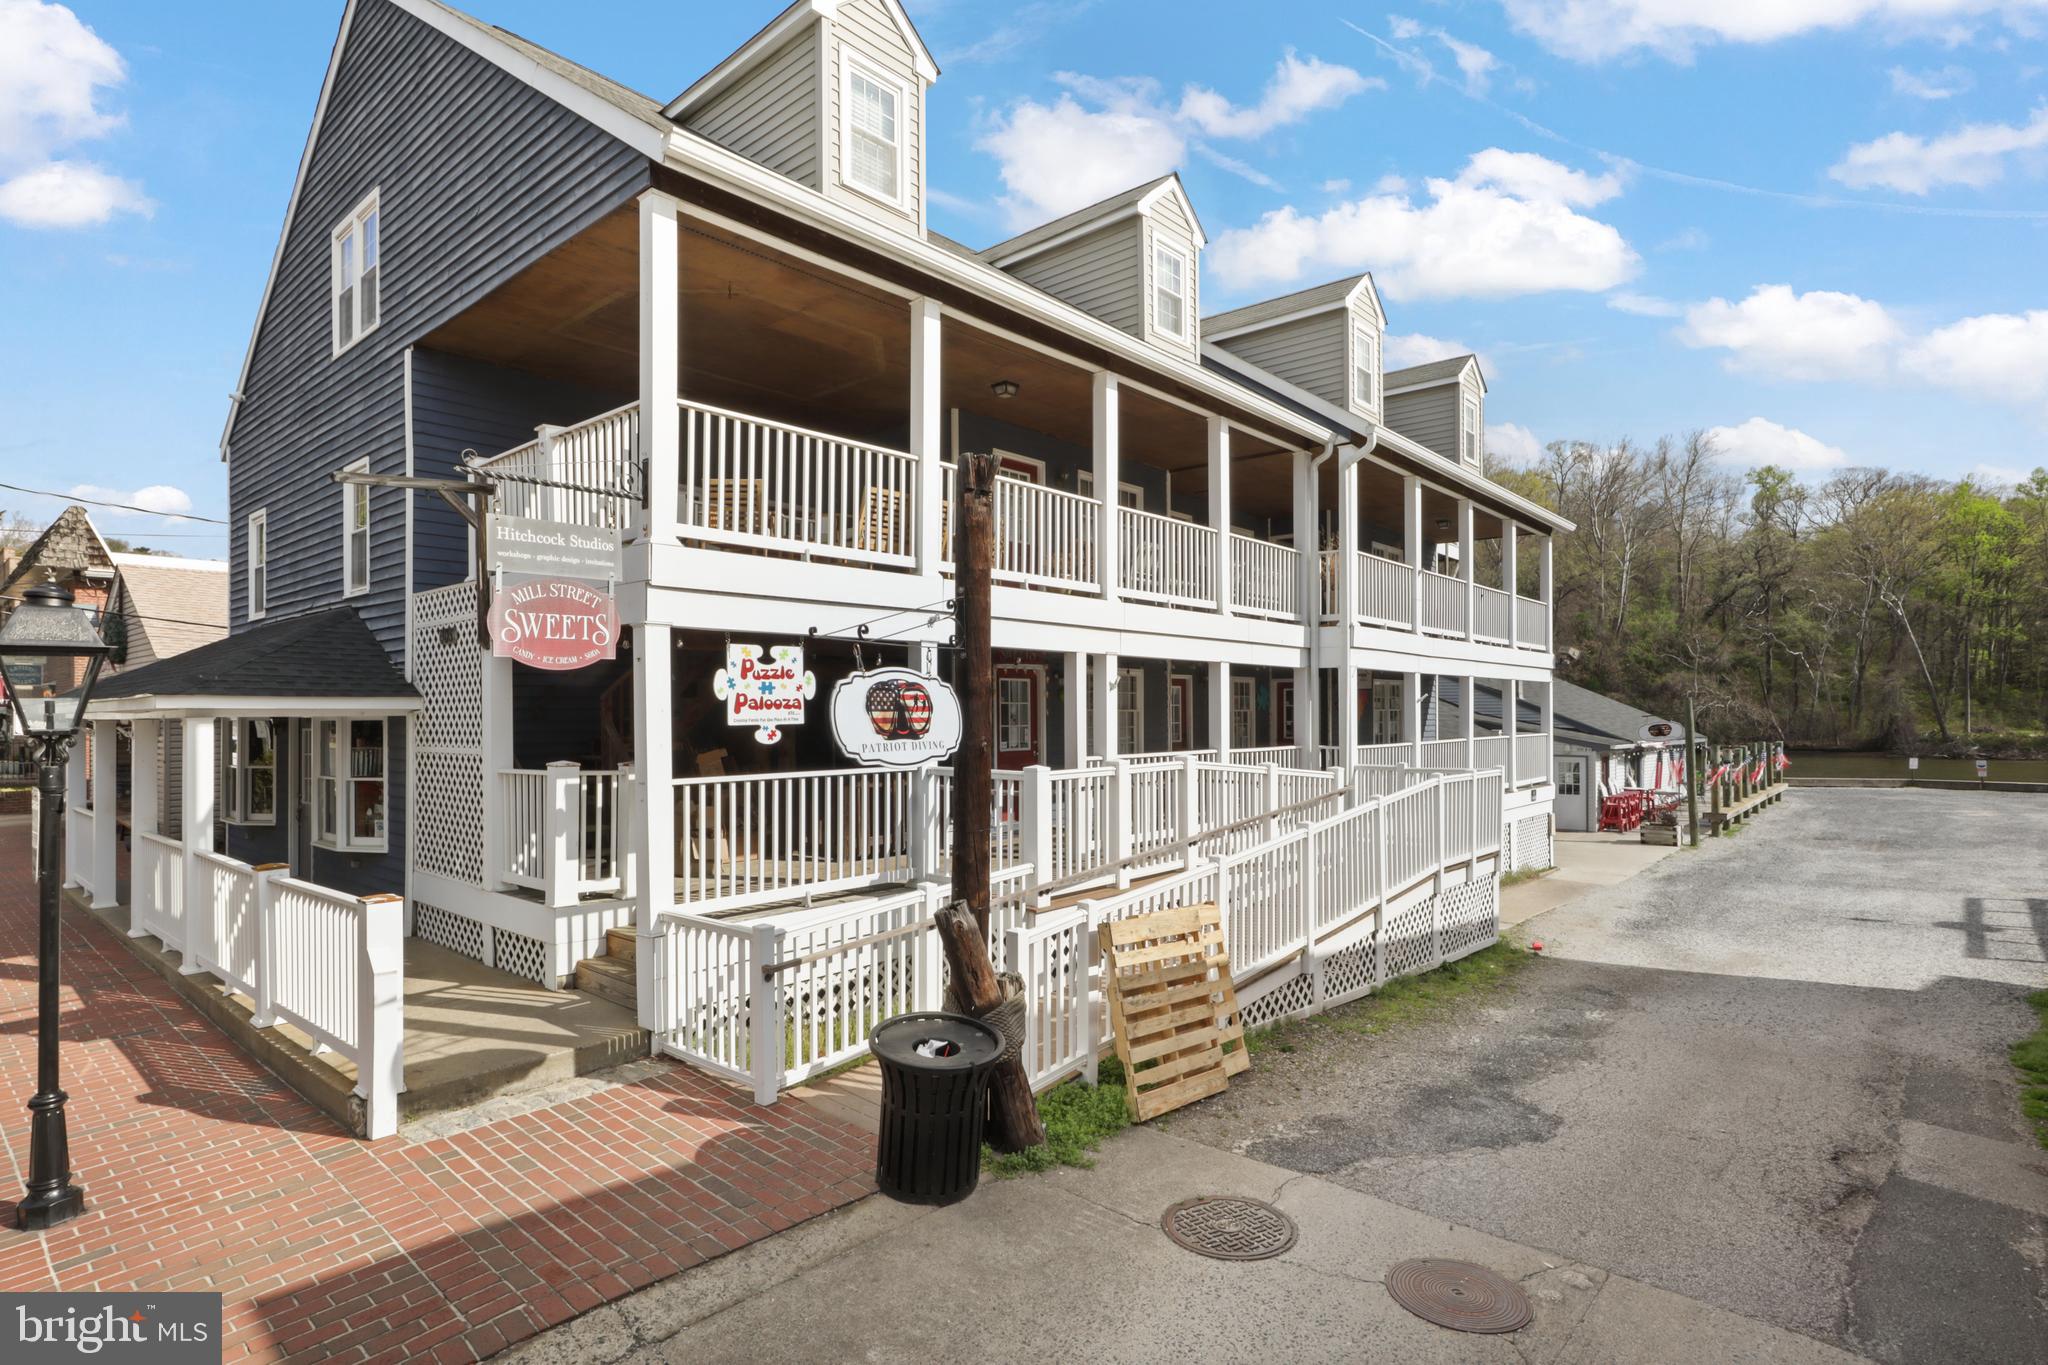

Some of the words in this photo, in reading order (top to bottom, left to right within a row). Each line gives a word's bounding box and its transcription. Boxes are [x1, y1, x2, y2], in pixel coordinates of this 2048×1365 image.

[496, 526, 566, 547] Hitchcock
[570, 534, 615, 551] Studios
[511, 584, 547, 605] MILL
[549, 583, 602, 609] STREET
[501, 608, 610, 646] SWEETS
[512, 645, 535, 660] CANDY
[542, 655, 555, 663] ICE
[555, 655, 578, 664] CREAM
[740, 658, 795, 681] Puzzle
[733, 692, 802, 714] Palooza
[862, 741, 908, 753] PATRIOT
[911, 740, 946, 751] DIVING
